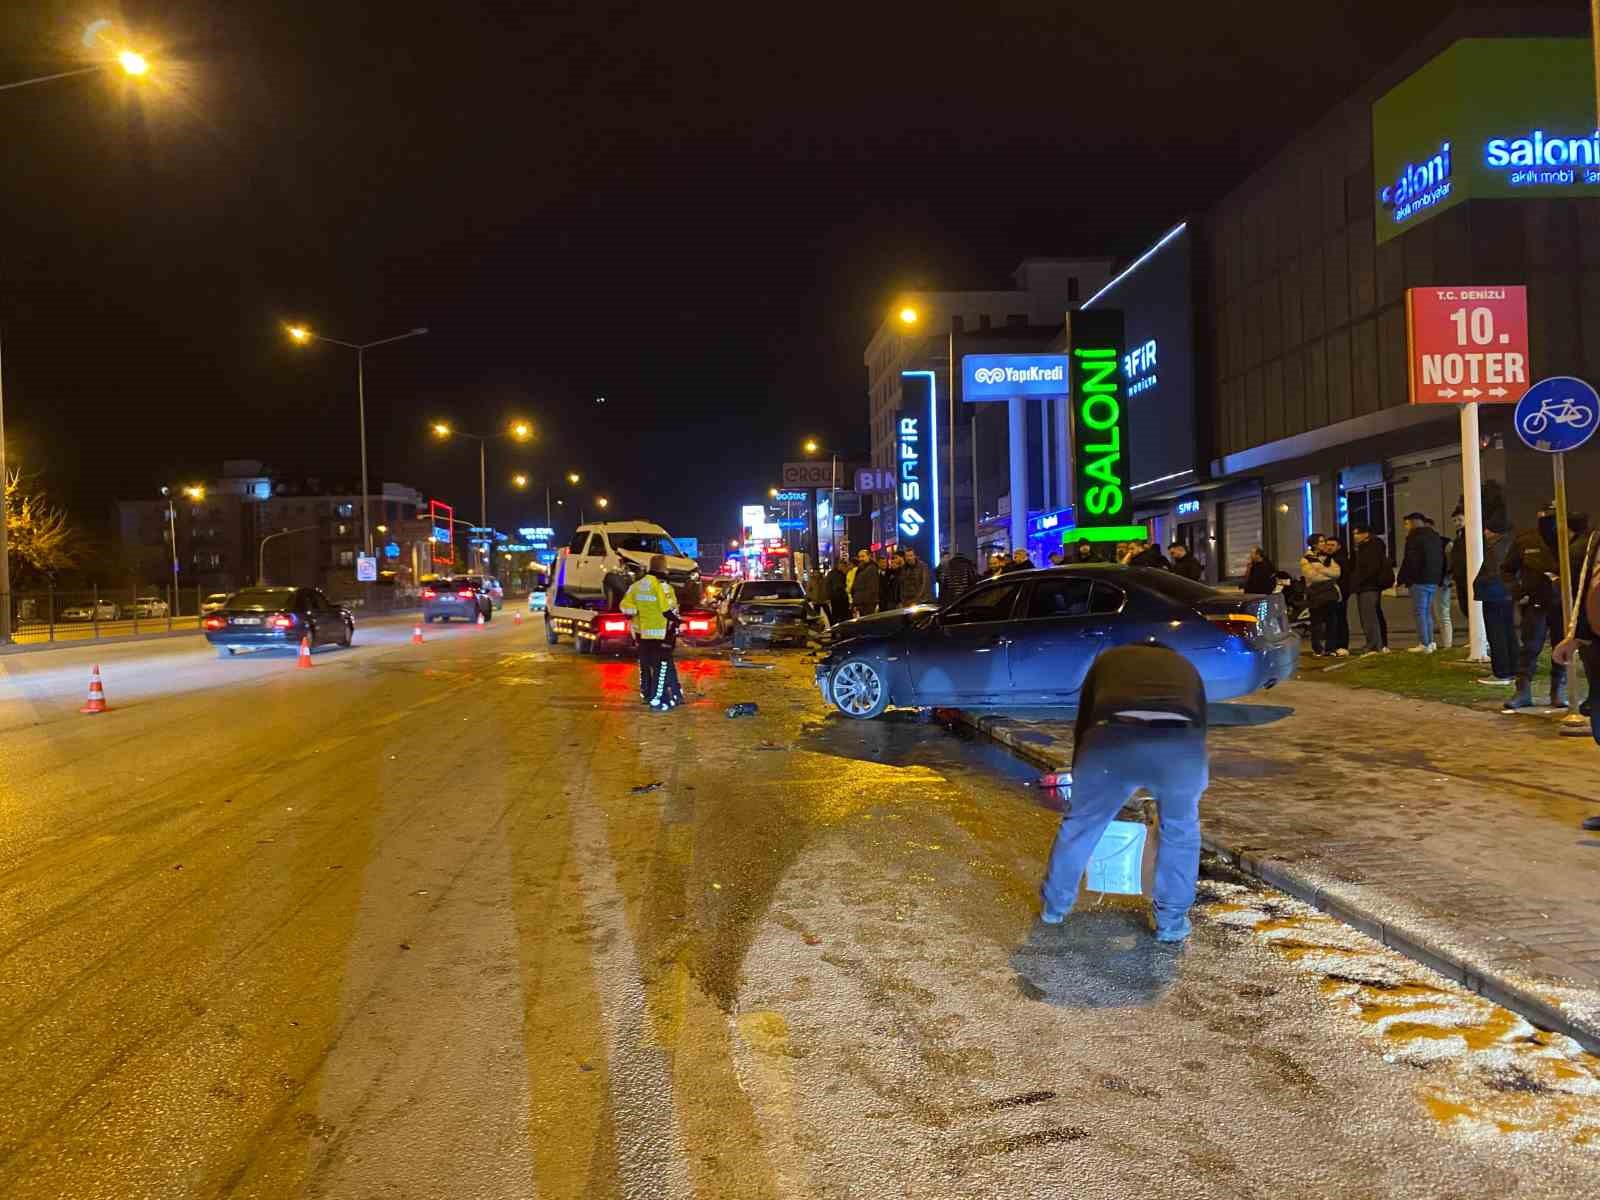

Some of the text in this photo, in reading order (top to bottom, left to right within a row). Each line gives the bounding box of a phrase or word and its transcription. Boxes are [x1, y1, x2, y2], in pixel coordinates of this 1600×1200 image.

[1487, 130, 1600, 166] saloni
[1436, 289, 1505, 300] T.C. DENİZLİ
[1450, 306, 1510, 346] 10.
[1421, 352, 1525, 385] NOTER
